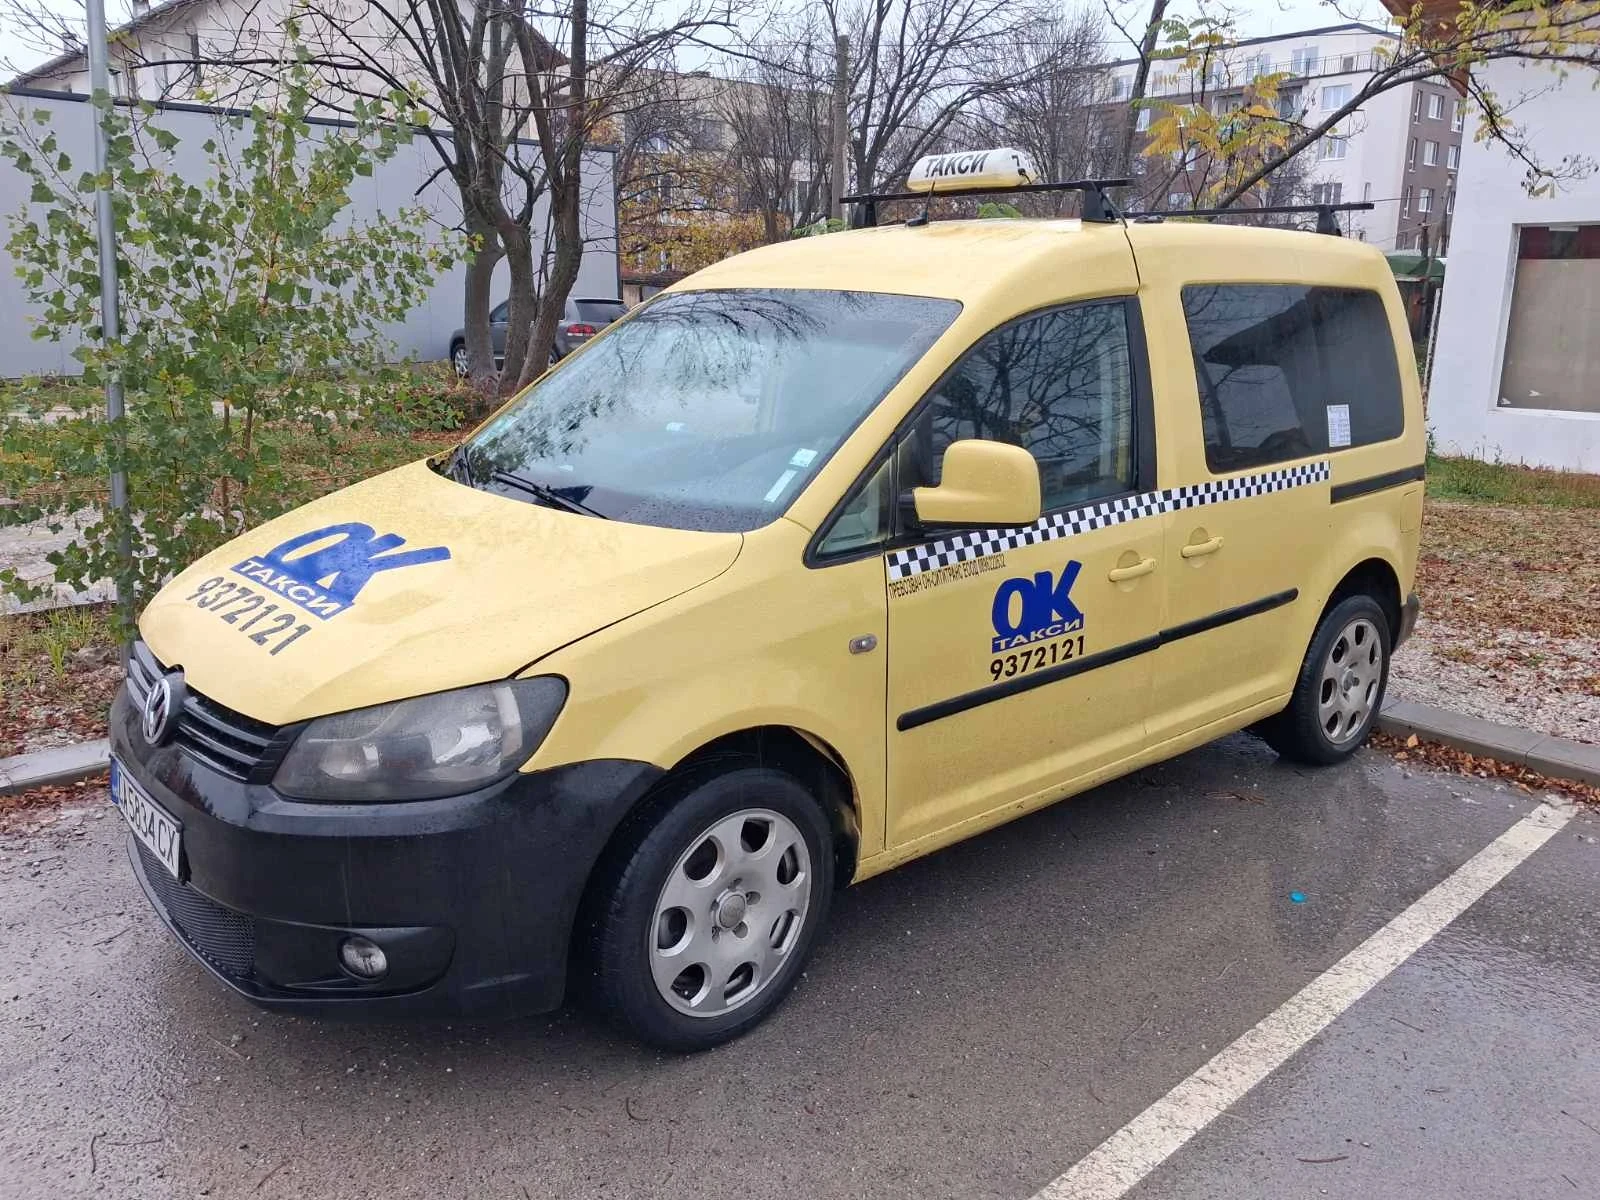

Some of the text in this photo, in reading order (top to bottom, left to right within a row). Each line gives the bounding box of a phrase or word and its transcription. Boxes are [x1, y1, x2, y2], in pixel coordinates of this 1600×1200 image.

[924, 153, 990, 178] ТАКСИ
[240, 560, 342, 616] ТАКСИ
[186, 576, 312, 656] 9372121
[995, 619, 1081, 650] ТАКСИ
[990, 635, 1085, 681] 9372121
